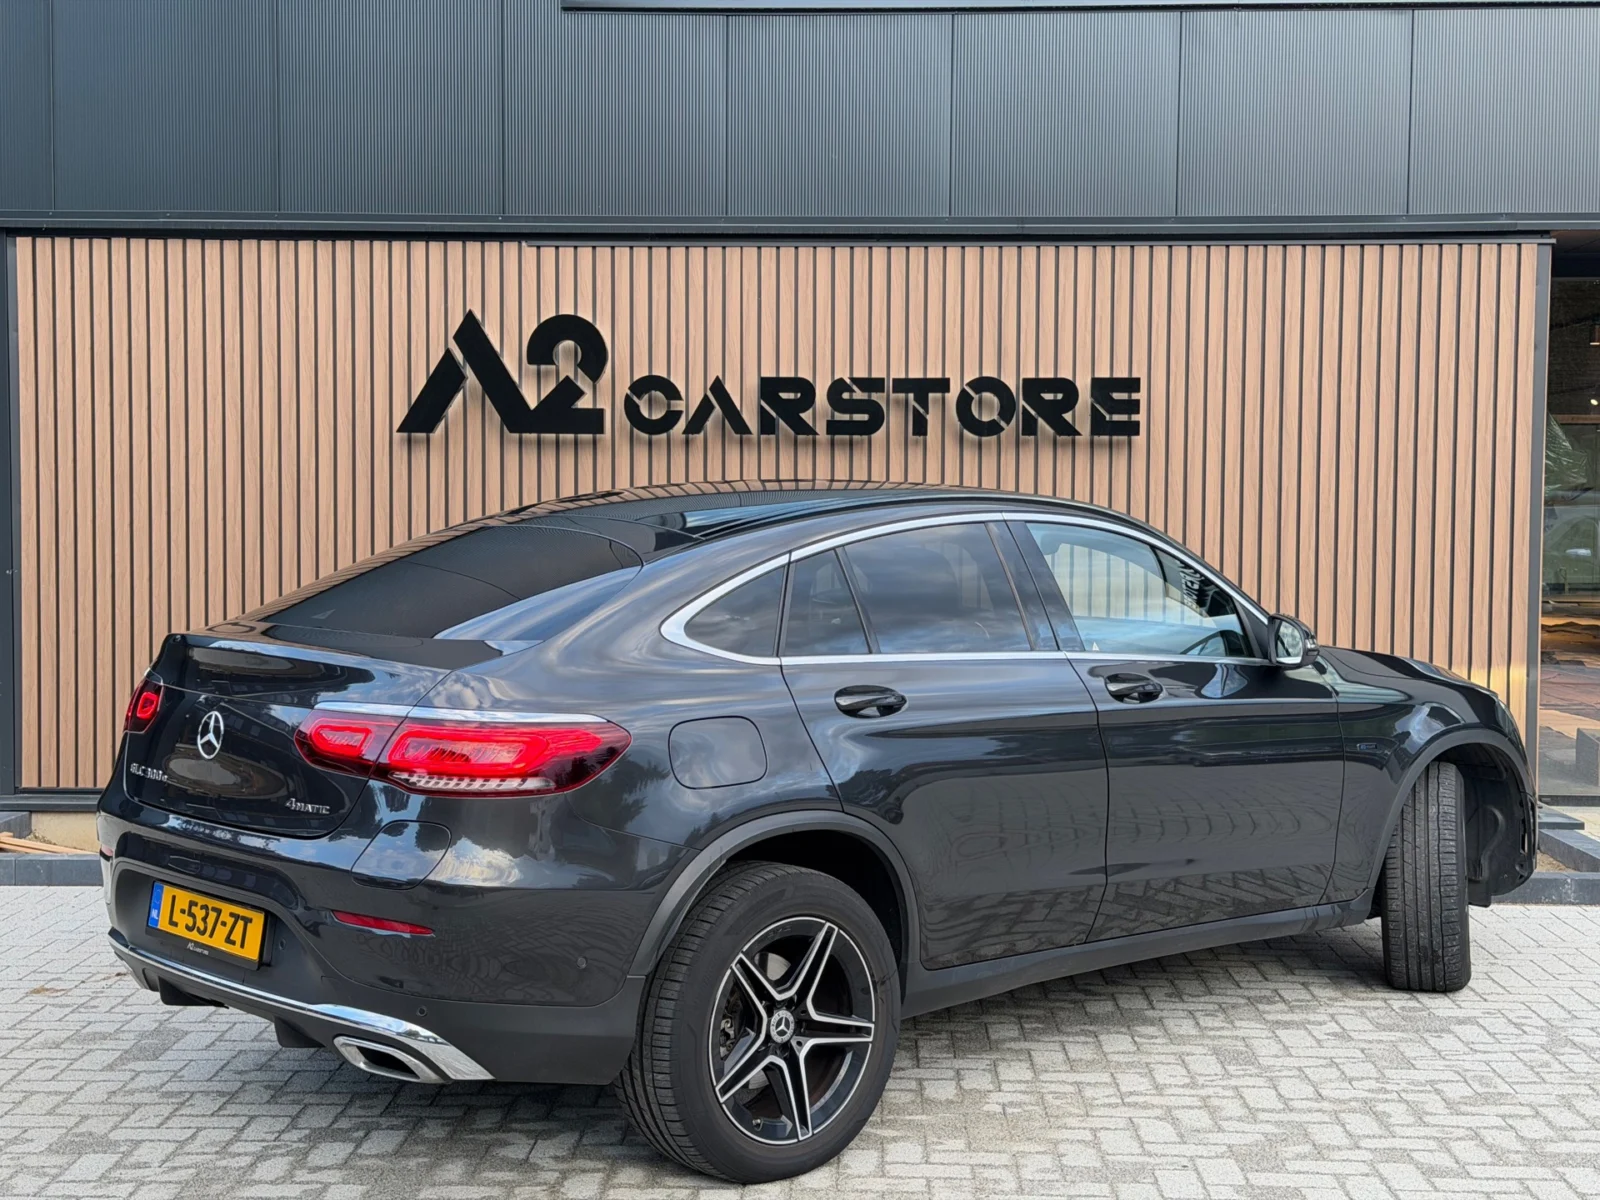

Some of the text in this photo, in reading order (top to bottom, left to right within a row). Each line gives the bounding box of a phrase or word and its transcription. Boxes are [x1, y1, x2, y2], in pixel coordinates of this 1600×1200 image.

[396, 308, 1141, 437] A2 CARSTORE
[285, 797, 330, 815] 4MATIC
[167, 894, 253, 949] L-537-ZT
